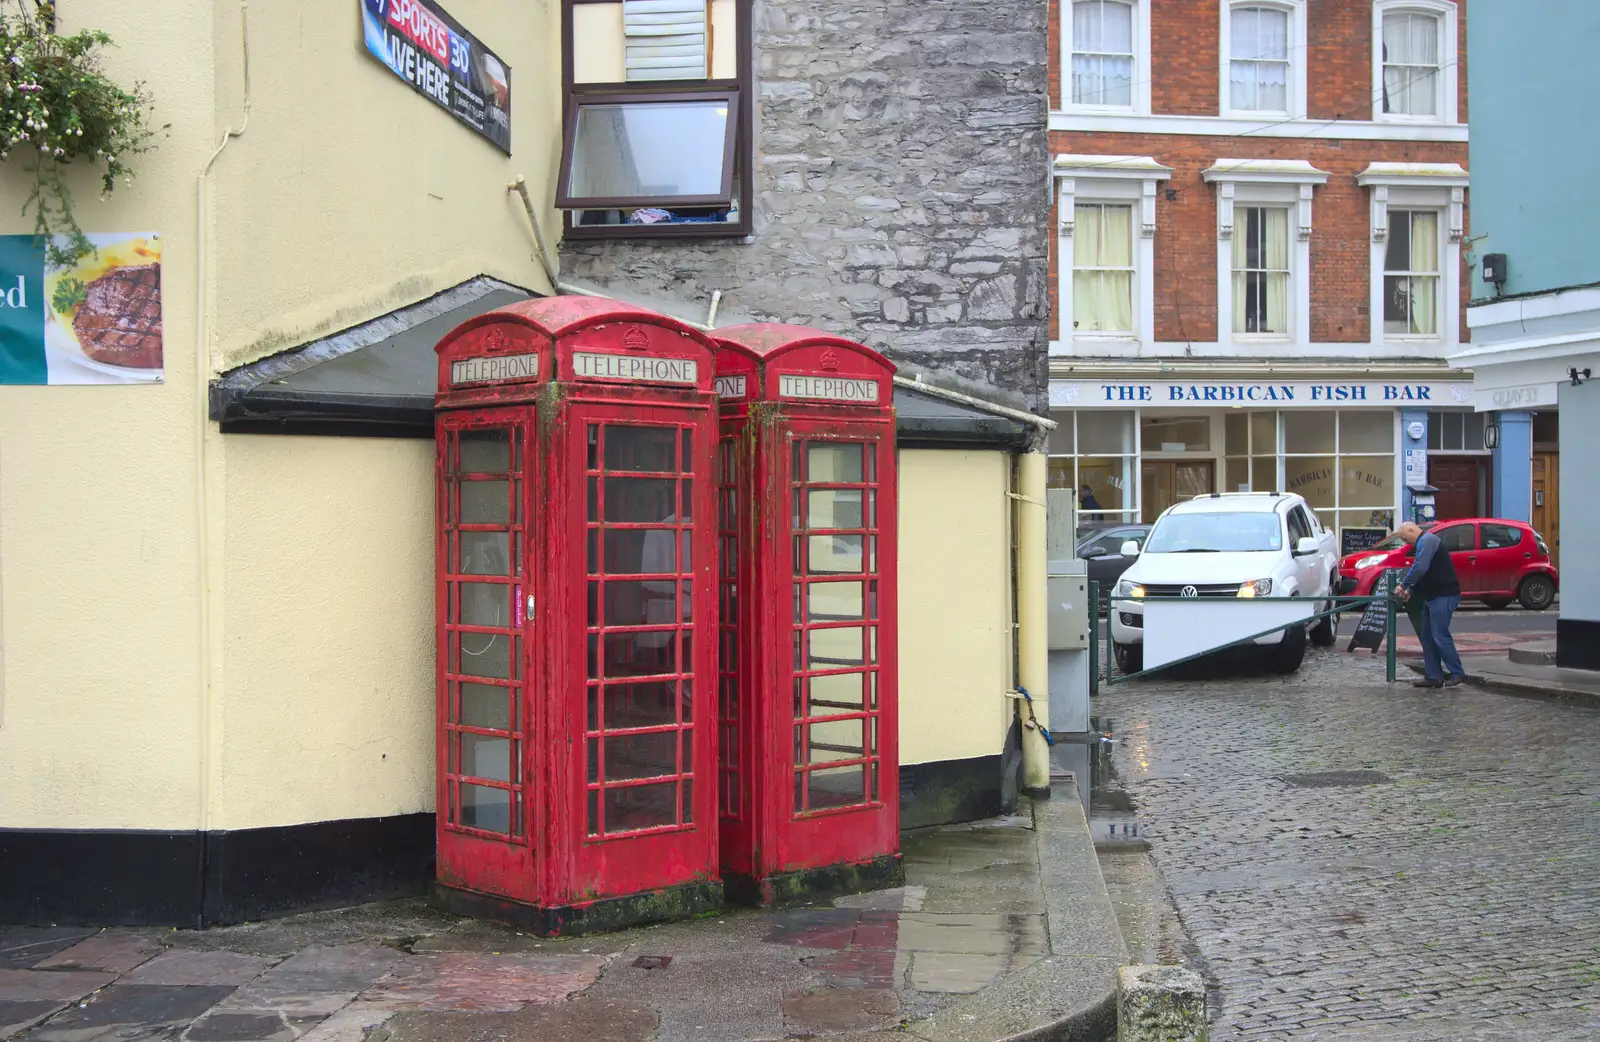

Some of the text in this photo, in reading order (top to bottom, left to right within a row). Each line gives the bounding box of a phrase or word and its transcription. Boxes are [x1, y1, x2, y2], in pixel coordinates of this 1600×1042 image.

[391, 0, 447, 58] SPORTS
[383, 28, 415, 81] LIVE
[416, 52, 449, 106] HERE
[456, 356, 537, 381] TELEPHONE
[579, 354, 692, 381] TELEPHONE
[782, 377, 874, 399] TELEPHONE
[1101, 384, 1431, 402] THE BARBICAN FISH BAR
